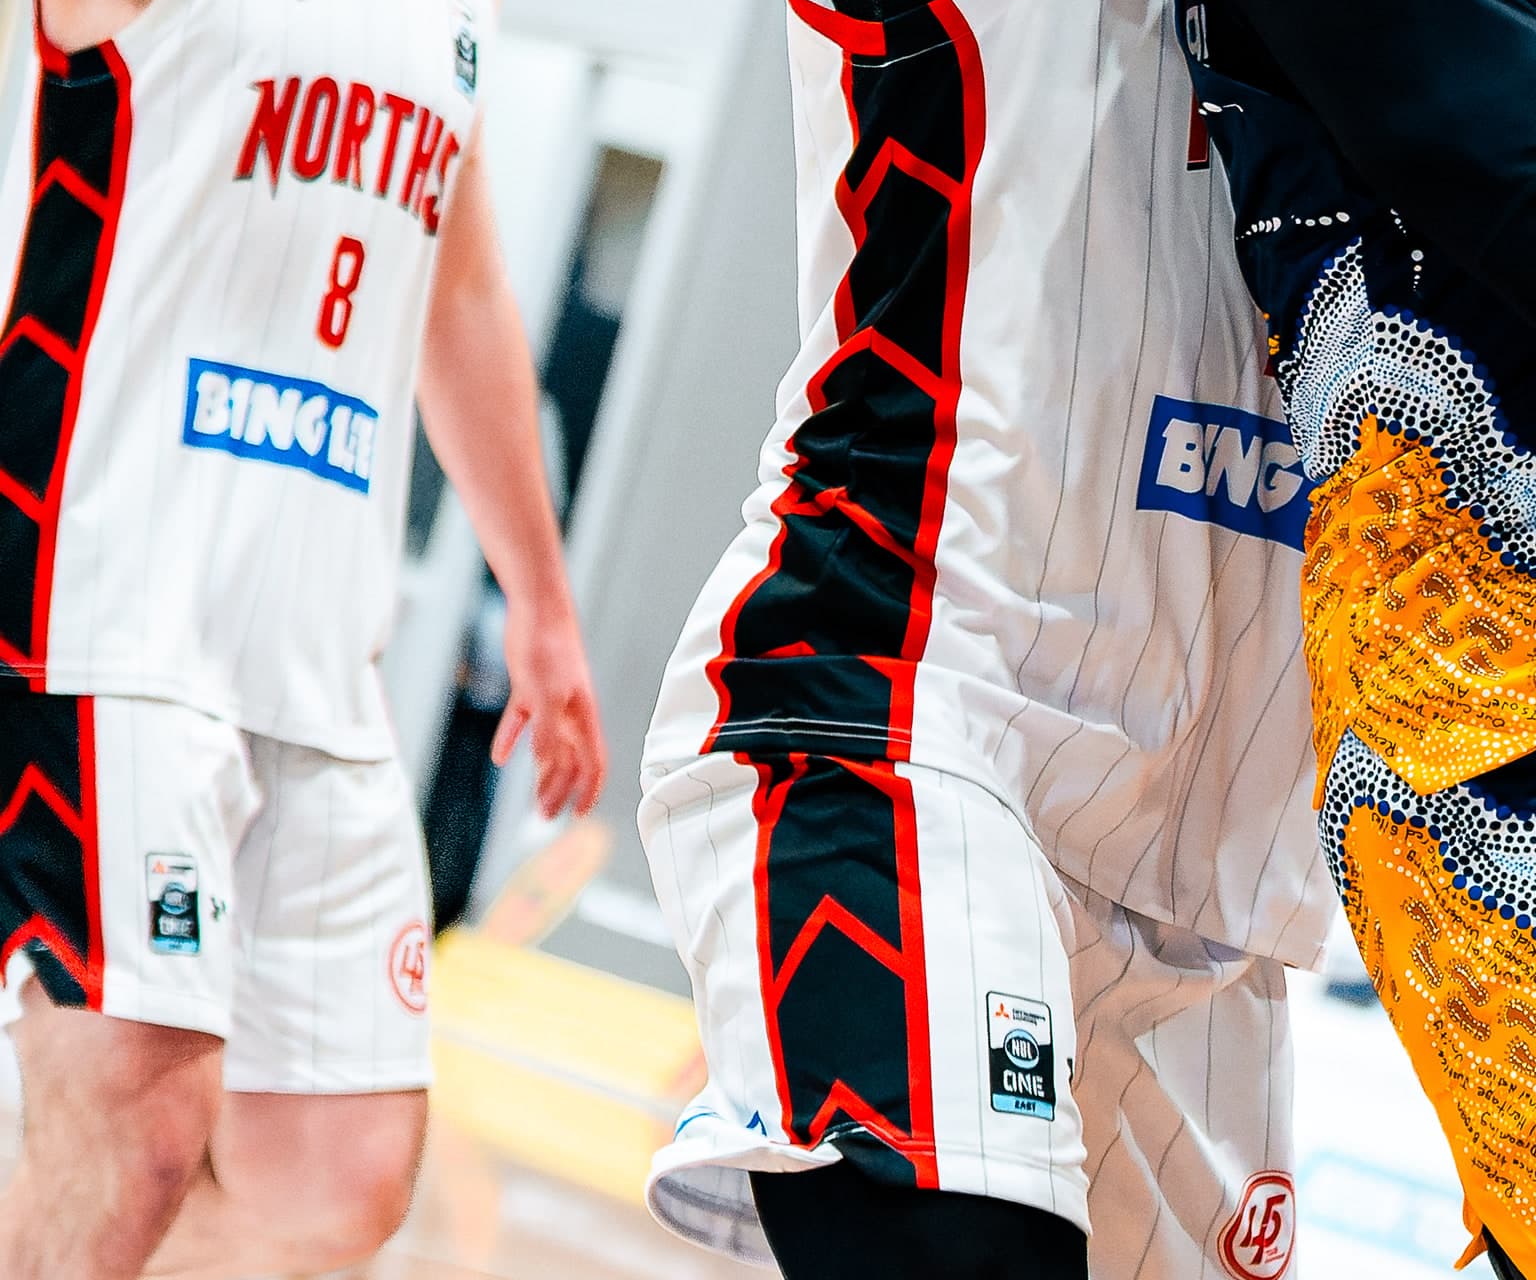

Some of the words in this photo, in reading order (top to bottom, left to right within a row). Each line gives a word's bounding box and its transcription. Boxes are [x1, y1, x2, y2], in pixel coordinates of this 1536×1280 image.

[233, 75, 461, 237] NORTHS
[315, 234, 365, 351] 8
[193, 371, 328, 457] BING
[1351, 717, 1397, 758] Respect
[1003, 1068, 1046, 1098] ONE
[1471, 1157, 1516, 1199] Respect
